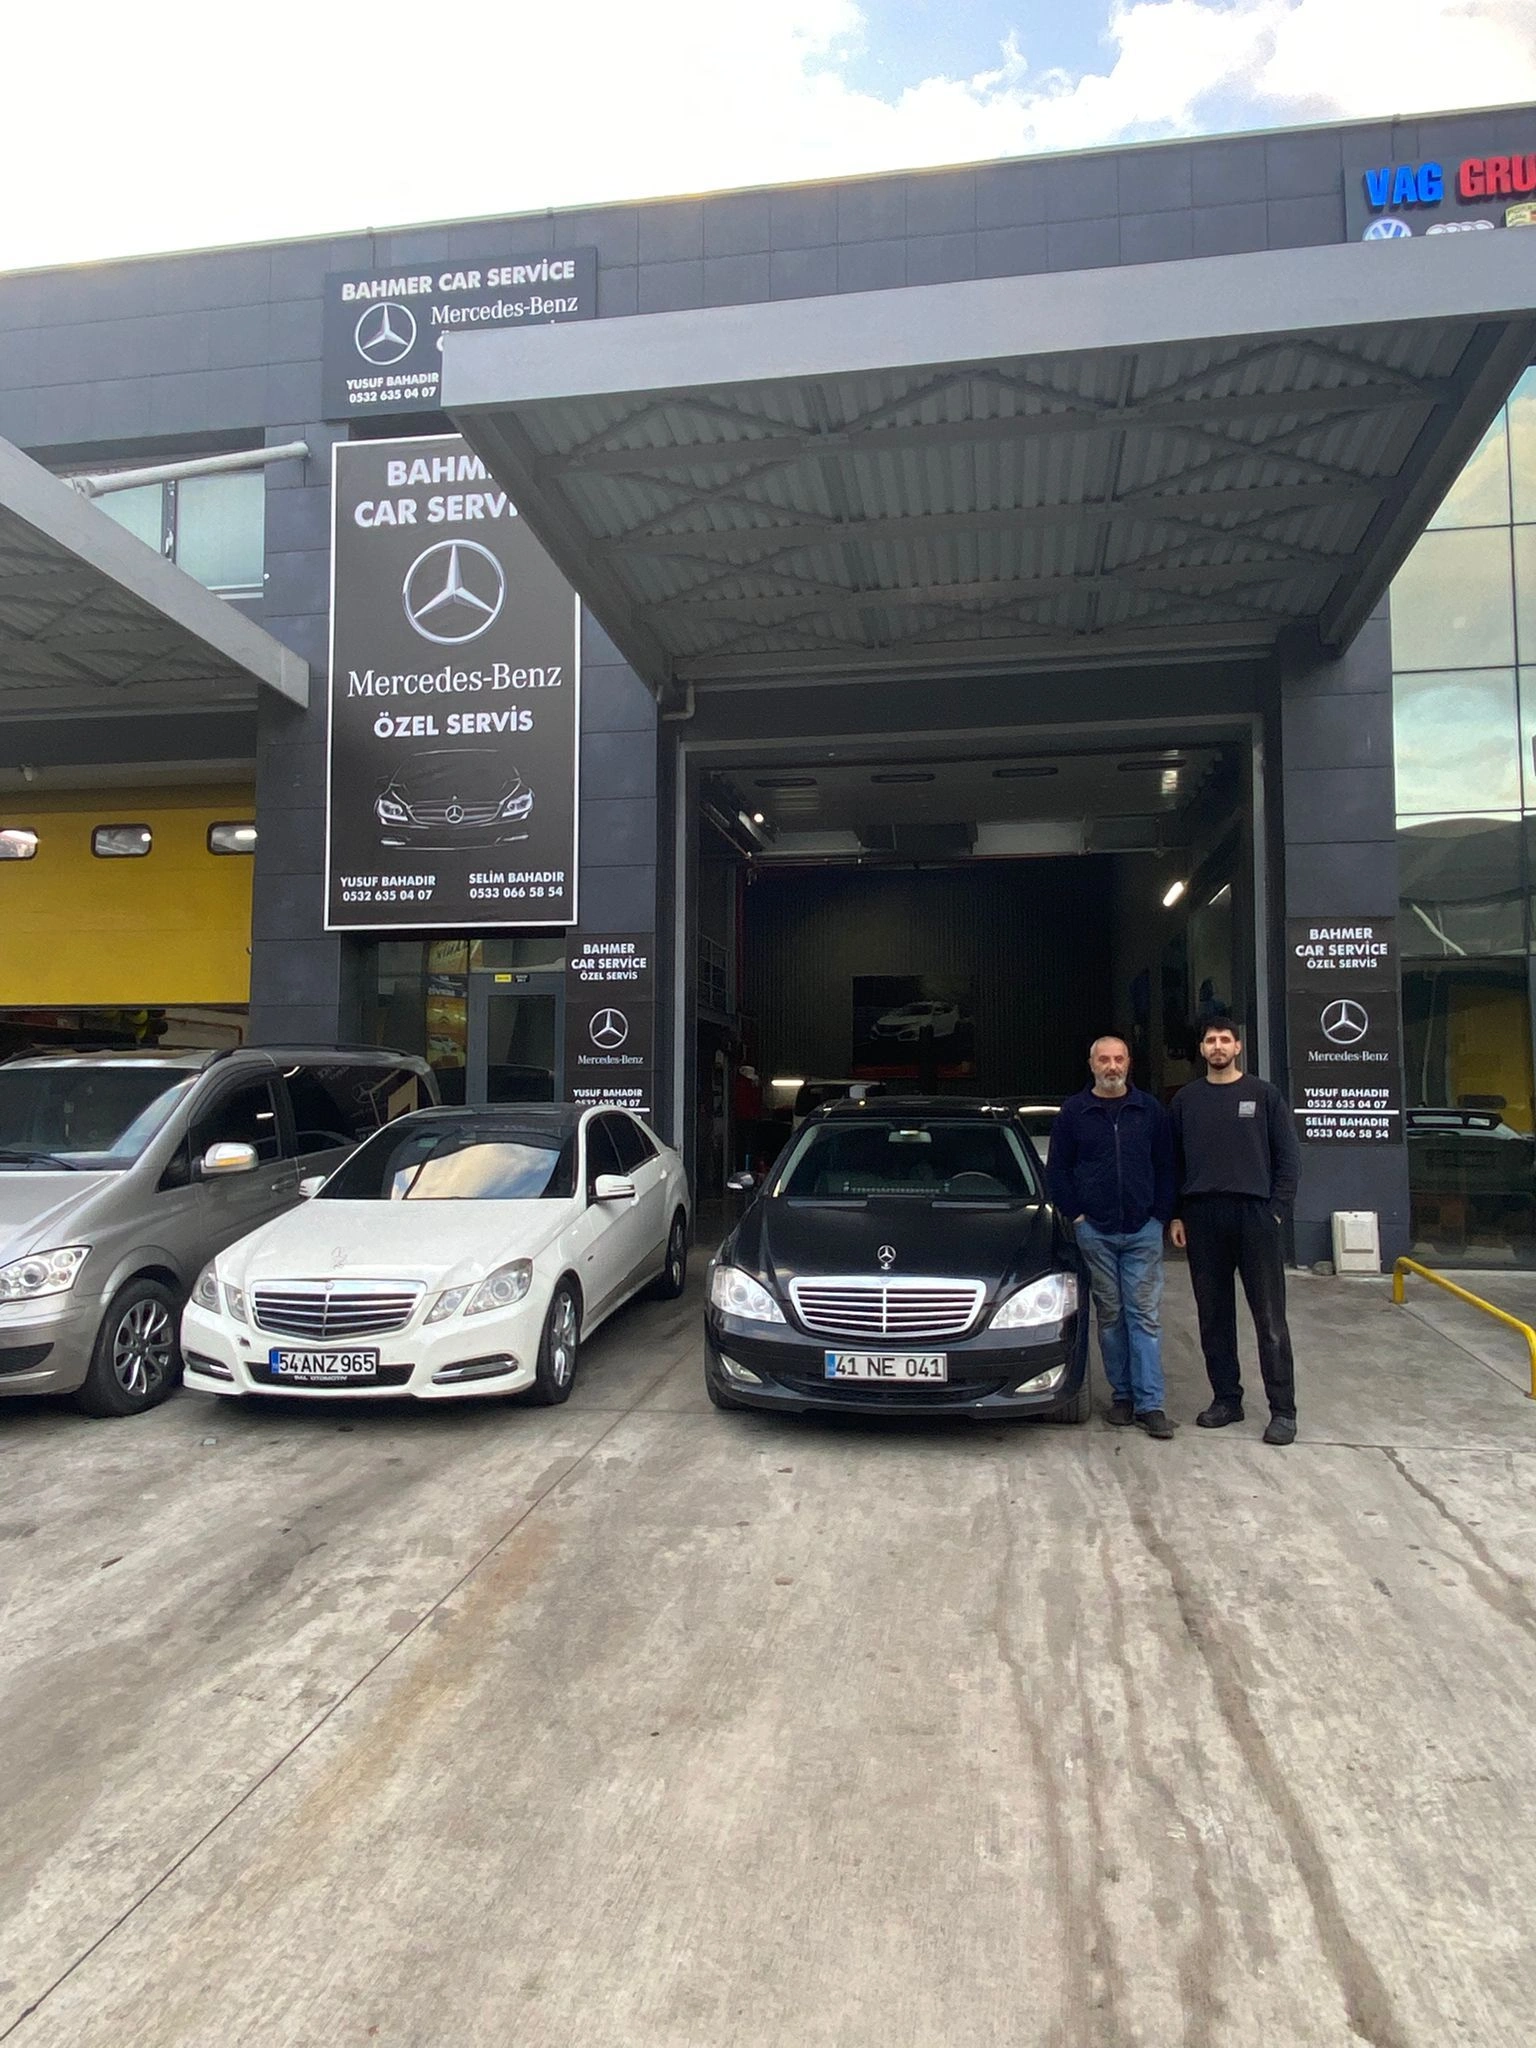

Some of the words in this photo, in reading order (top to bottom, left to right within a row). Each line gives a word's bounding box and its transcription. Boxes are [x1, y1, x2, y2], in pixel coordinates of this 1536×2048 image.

[1365, 161, 1444, 207] VAG
[1459, 153, 1536, 197] GRU
[342, 276, 432, 301] BAHMER
[438, 270, 481, 292] CAR
[487, 258, 576, 287] SERVİCE
[431, 295, 579, 326] Mercedes-Benz
[346, 377, 384, 390] YUSUF
[386, 372, 439, 387] BAHADIR
[349, 391, 377, 403] 0532
[380, 389, 401, 401] 635
[404, 388, 419, 398] 04
[421, 386, 436, 397] 07
[387, 455, 494, 487] BAHM
[354, 499, 417, 528] CAR
[347, 662, 562, 698] Mercedes-Benz
[373, 711, 439, 738] ÖZEL
[446, 705, 534, 735] SERVİS
[340, 876, 379, 887] YUSUF
[381, 875, 436, 886] BAHADIR
[469, 870, 504, 884] SELİM
[508, 871, 564, 883] BAHADIR
[343, 890, 371, 901] 0532
[375, 890, 396, 901] 635
[400, 890, 414, 900] 04
[417, 889, 433, 900] 07
[469, 887, 500, 898] 0533
[503, 887, 526, 898] 066
[529, 886, 544, 897] 58
[548, 886, 563, 897] 54
[1309, 927, 1373, 940] BAHMER
[583, 943, 635, 954] BAHMER
[1295, 944, 1324, 957] CAR
[1328, 940, 1388, 956] SERVİCE
[571, 958, 595, 969] CAR
[598, 955, 647, 969] SERVİCE
[1306, 957, 1336, 969] ÖZEL
[1339, 956, 1377, 968] SERVİS
[580, 970, 604, 980] ÖZEL
[606, 970, 638, 980] SERVİS
[577, 1054, 644, 1065] Mercedes-Benz
[1308, 1051, 1389, 1061] Mercedes-Benz
[573, 1089, 601, 1097] YUSUF
[603, 1089, 643, 1097] BAHADIR
[1304, 1088, 1339, 1097] YUSUF
[1341, 1088, 1389, 1098] BAHADIR
[616, 1099, 627, 1107] 04
[629, 1099, 640, 1107] 07
[1307, 1100, 1333, 1108] 0532
[1335, 1100, 1355, 1109] 635
[1357, 1100, 1371, 1109] 04
[1373, 1100, 1387, 1109] 07
[1305, 1115, 1337, 1126] SELİM
[1340, 1117, 1389, 1127] BAHADIR
[1306, 1129, 1333, 1138] 0533
[1335, 1129, 1356, 1138] 066
[1359, 1129, 1372, 1138] 58
[1375, 1129, 1389, 1138] 54
[836, 1356, 858, 1376] 41
[867, 1357, 896, 1377] NE
[905, 1358, 942, 1377] 041
